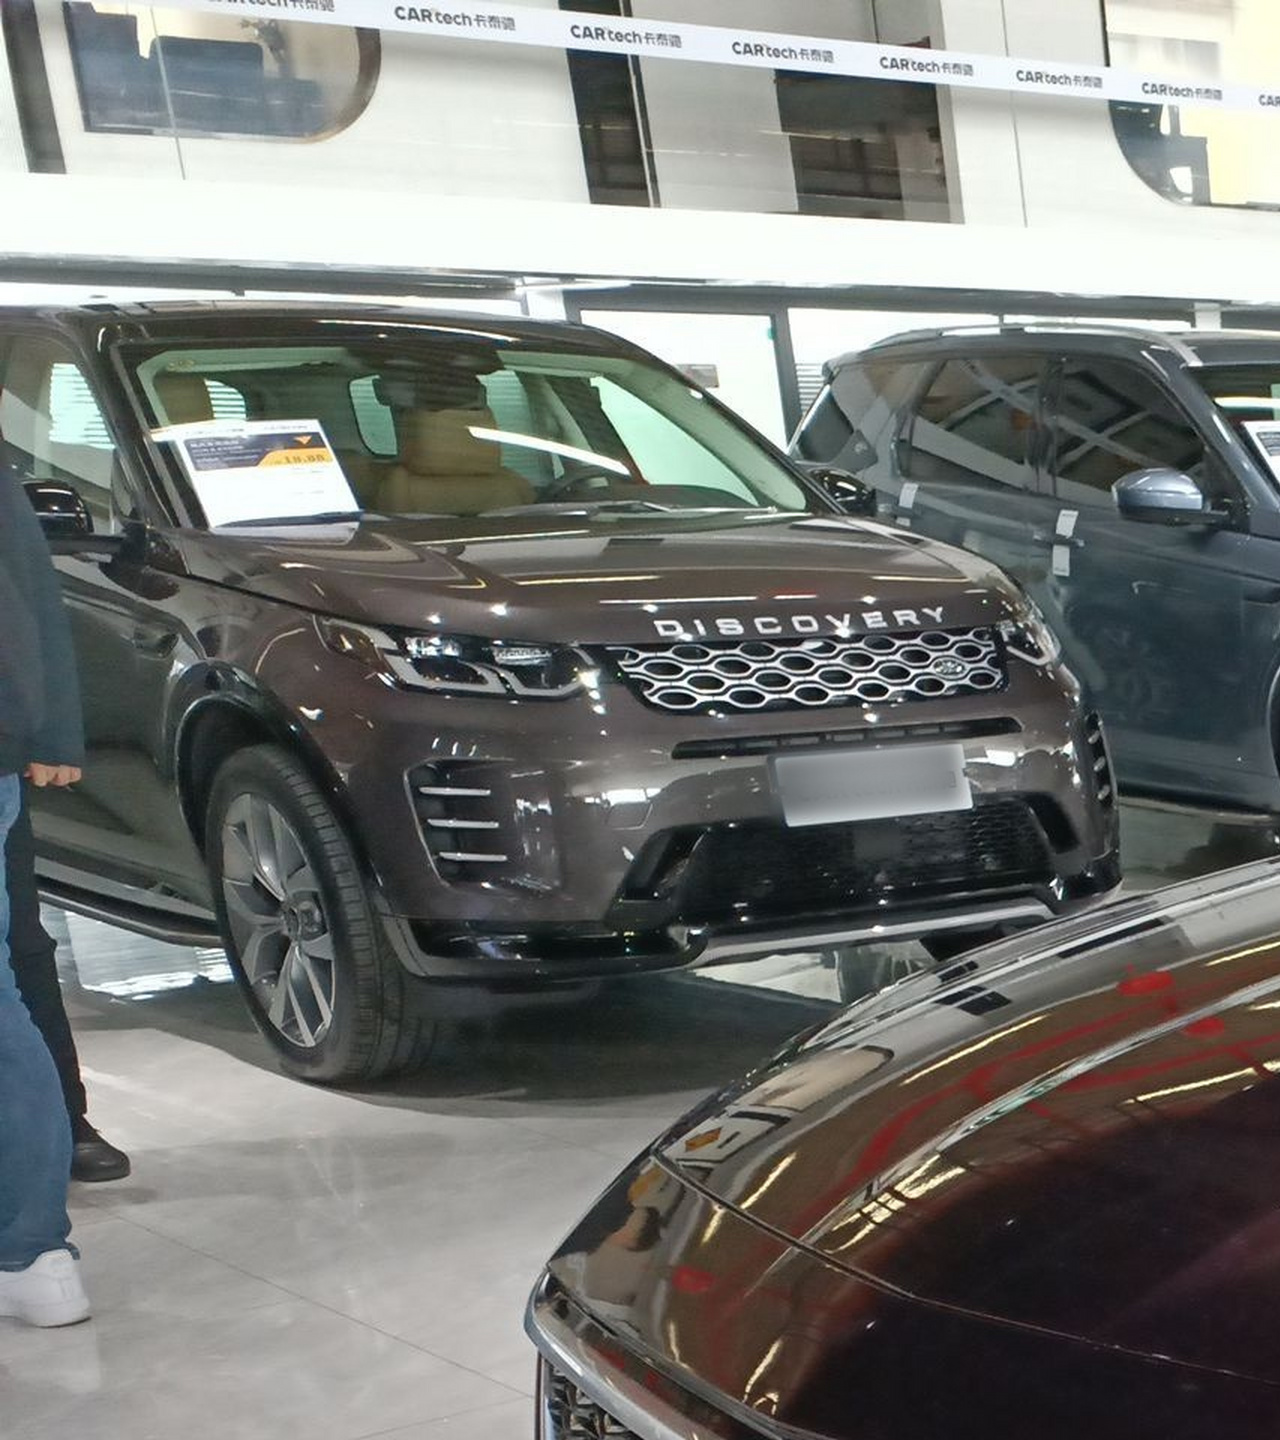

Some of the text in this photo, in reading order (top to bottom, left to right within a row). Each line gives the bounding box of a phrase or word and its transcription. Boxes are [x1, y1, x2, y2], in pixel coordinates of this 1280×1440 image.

[394, 6, 472, 27] CARtech
[570, 25, 642, 45] CARtech
[732, 41, 797, 60] CARtech
[880, 56, 940, 74] CARtech
[653, 606, 945, 638] DISCOVERY
